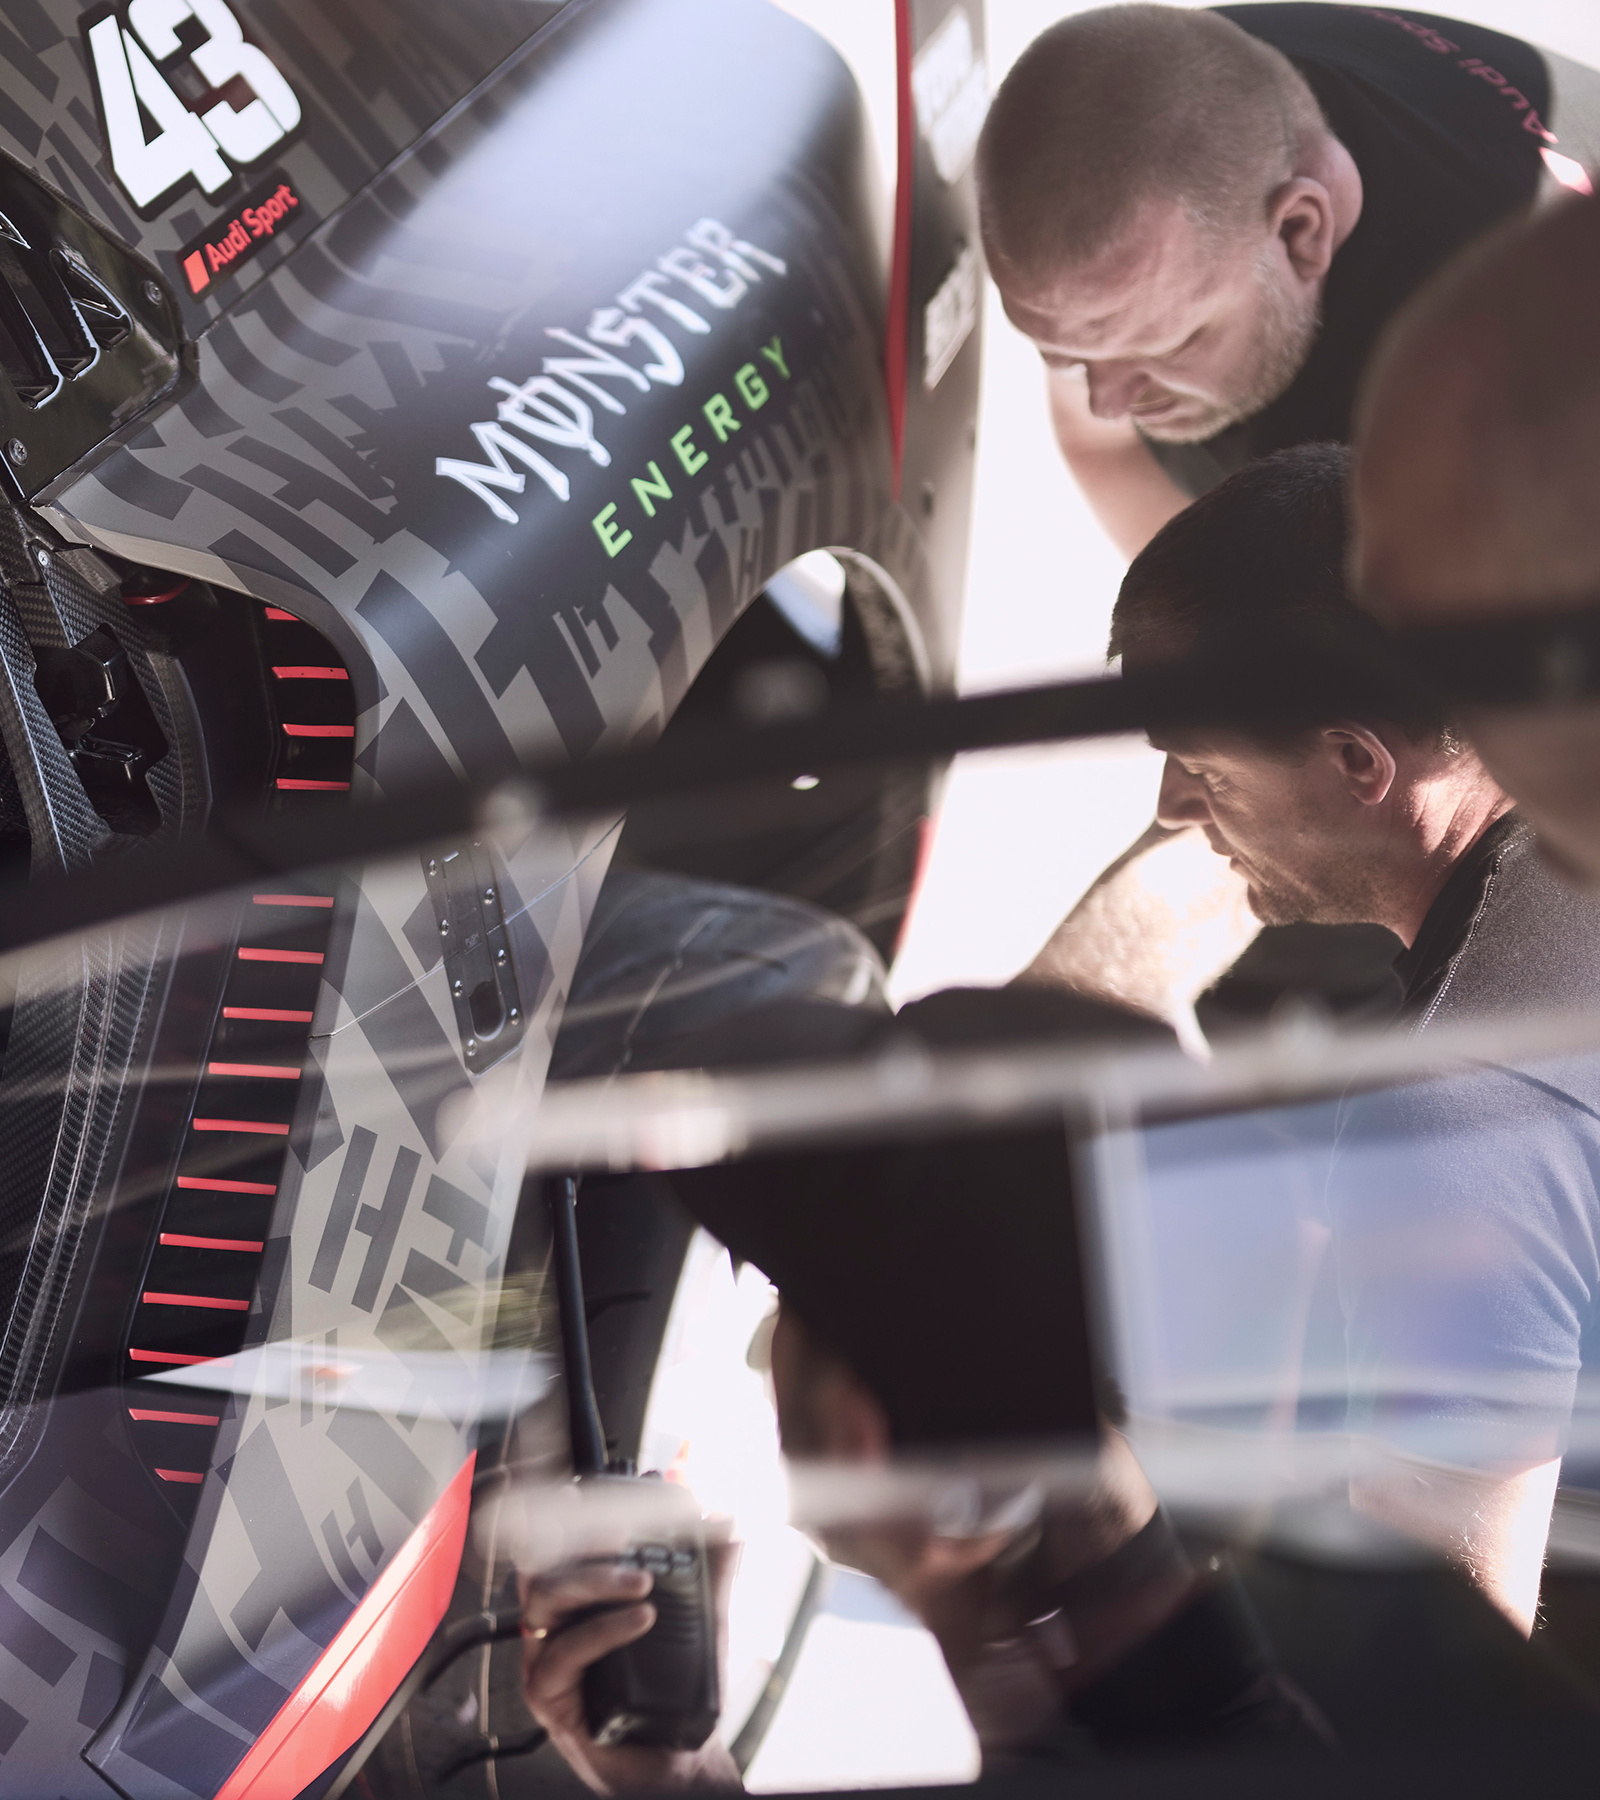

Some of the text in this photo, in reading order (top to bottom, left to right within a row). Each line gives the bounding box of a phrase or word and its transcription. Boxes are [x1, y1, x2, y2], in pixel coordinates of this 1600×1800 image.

[88, 0, 302, 208] 43
[204, 184, 299, 272] Audi Sport
[591, 335, 791, 558] ENERGY
